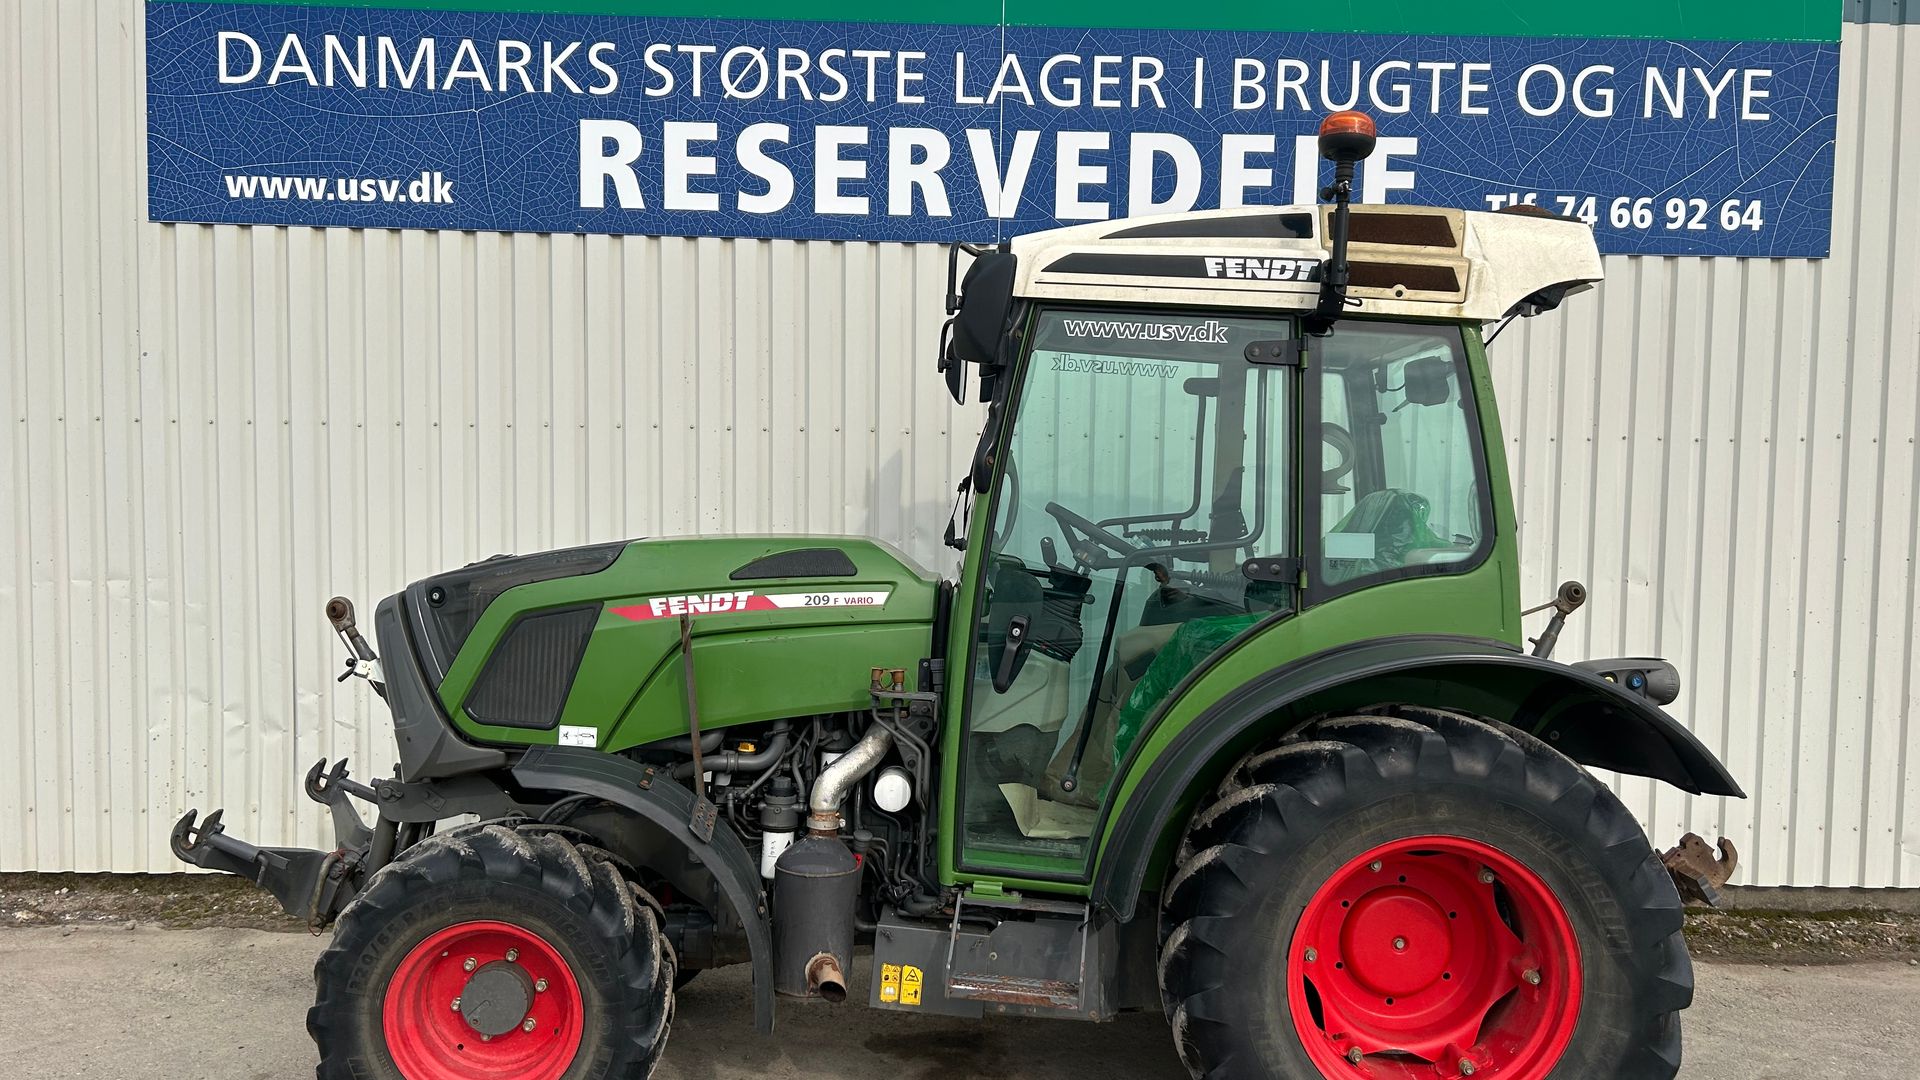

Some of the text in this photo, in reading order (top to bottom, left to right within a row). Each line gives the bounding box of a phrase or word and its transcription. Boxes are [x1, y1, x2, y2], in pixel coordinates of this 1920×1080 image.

[217, 31, 1773, 121] DANMARKS STØRSTE LAGER I BRUGTE OG NYE
[224, 171, 454, 204] www.usv.dk
[1610, 196, 1653, 229] 66
[1665, 197, 1708, 230] 92
[1720, 198, 1764, 231] 64
[1204, 256, 1319, 281] FENDT
[1064, 319, 1228, 344] www.usv.dk
[649, 590, 754, 617] FENDT
[804, 595, 830, 606] 209
[844, 596, 874, 605] VARIO
